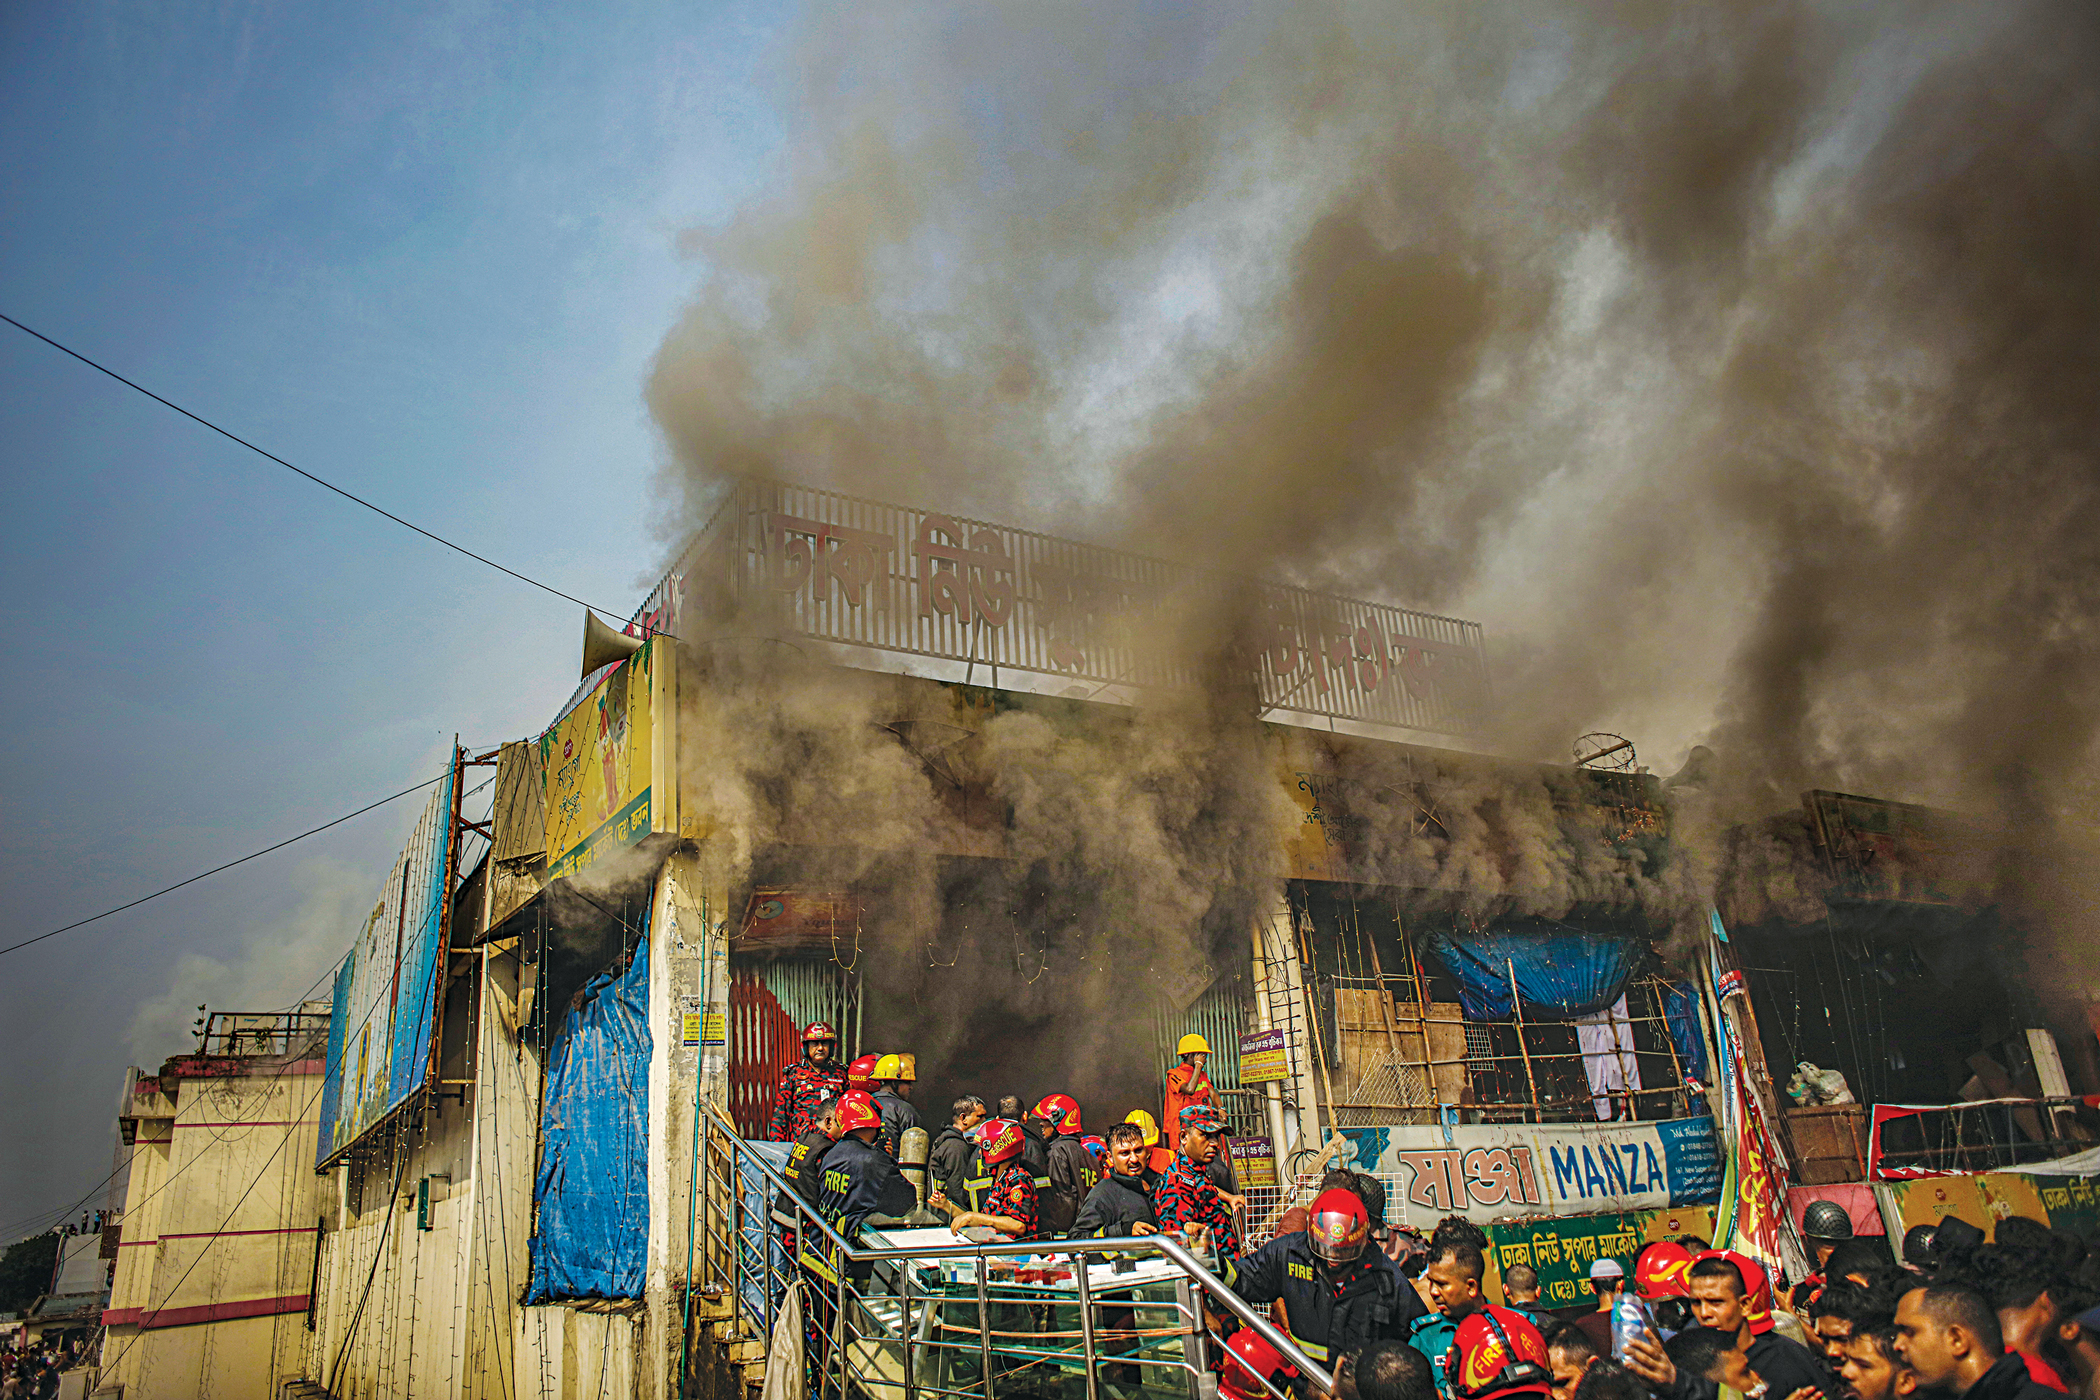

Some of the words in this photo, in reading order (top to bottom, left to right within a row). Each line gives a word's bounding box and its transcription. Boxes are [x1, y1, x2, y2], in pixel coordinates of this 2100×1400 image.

[769, 513, 894, 612] ঢাকা
[912, 514, 1016, 628] নিউ
[791, 1142, 810, 1161] FIRE
[825, 1170, 851, 1195] FIRE
[1550, 1141, 1666, 1200] MANZA
[1499, 1243, 1532, 1269] ঢাকা
[1533, 1231, 1560, 1267] নিউ
[1561, 1235, 1598, 1275] সুপার
[1598, 1221, 1638, 1259] মার্কেট
[1288, 1262, 1314, 1281] FIRE
[1550, 1279, 1576, 1301] (দঃ)
[1474, 1341, 1504, 1375] FIRE
[1520, 1332, 1542, 1363] RESC
